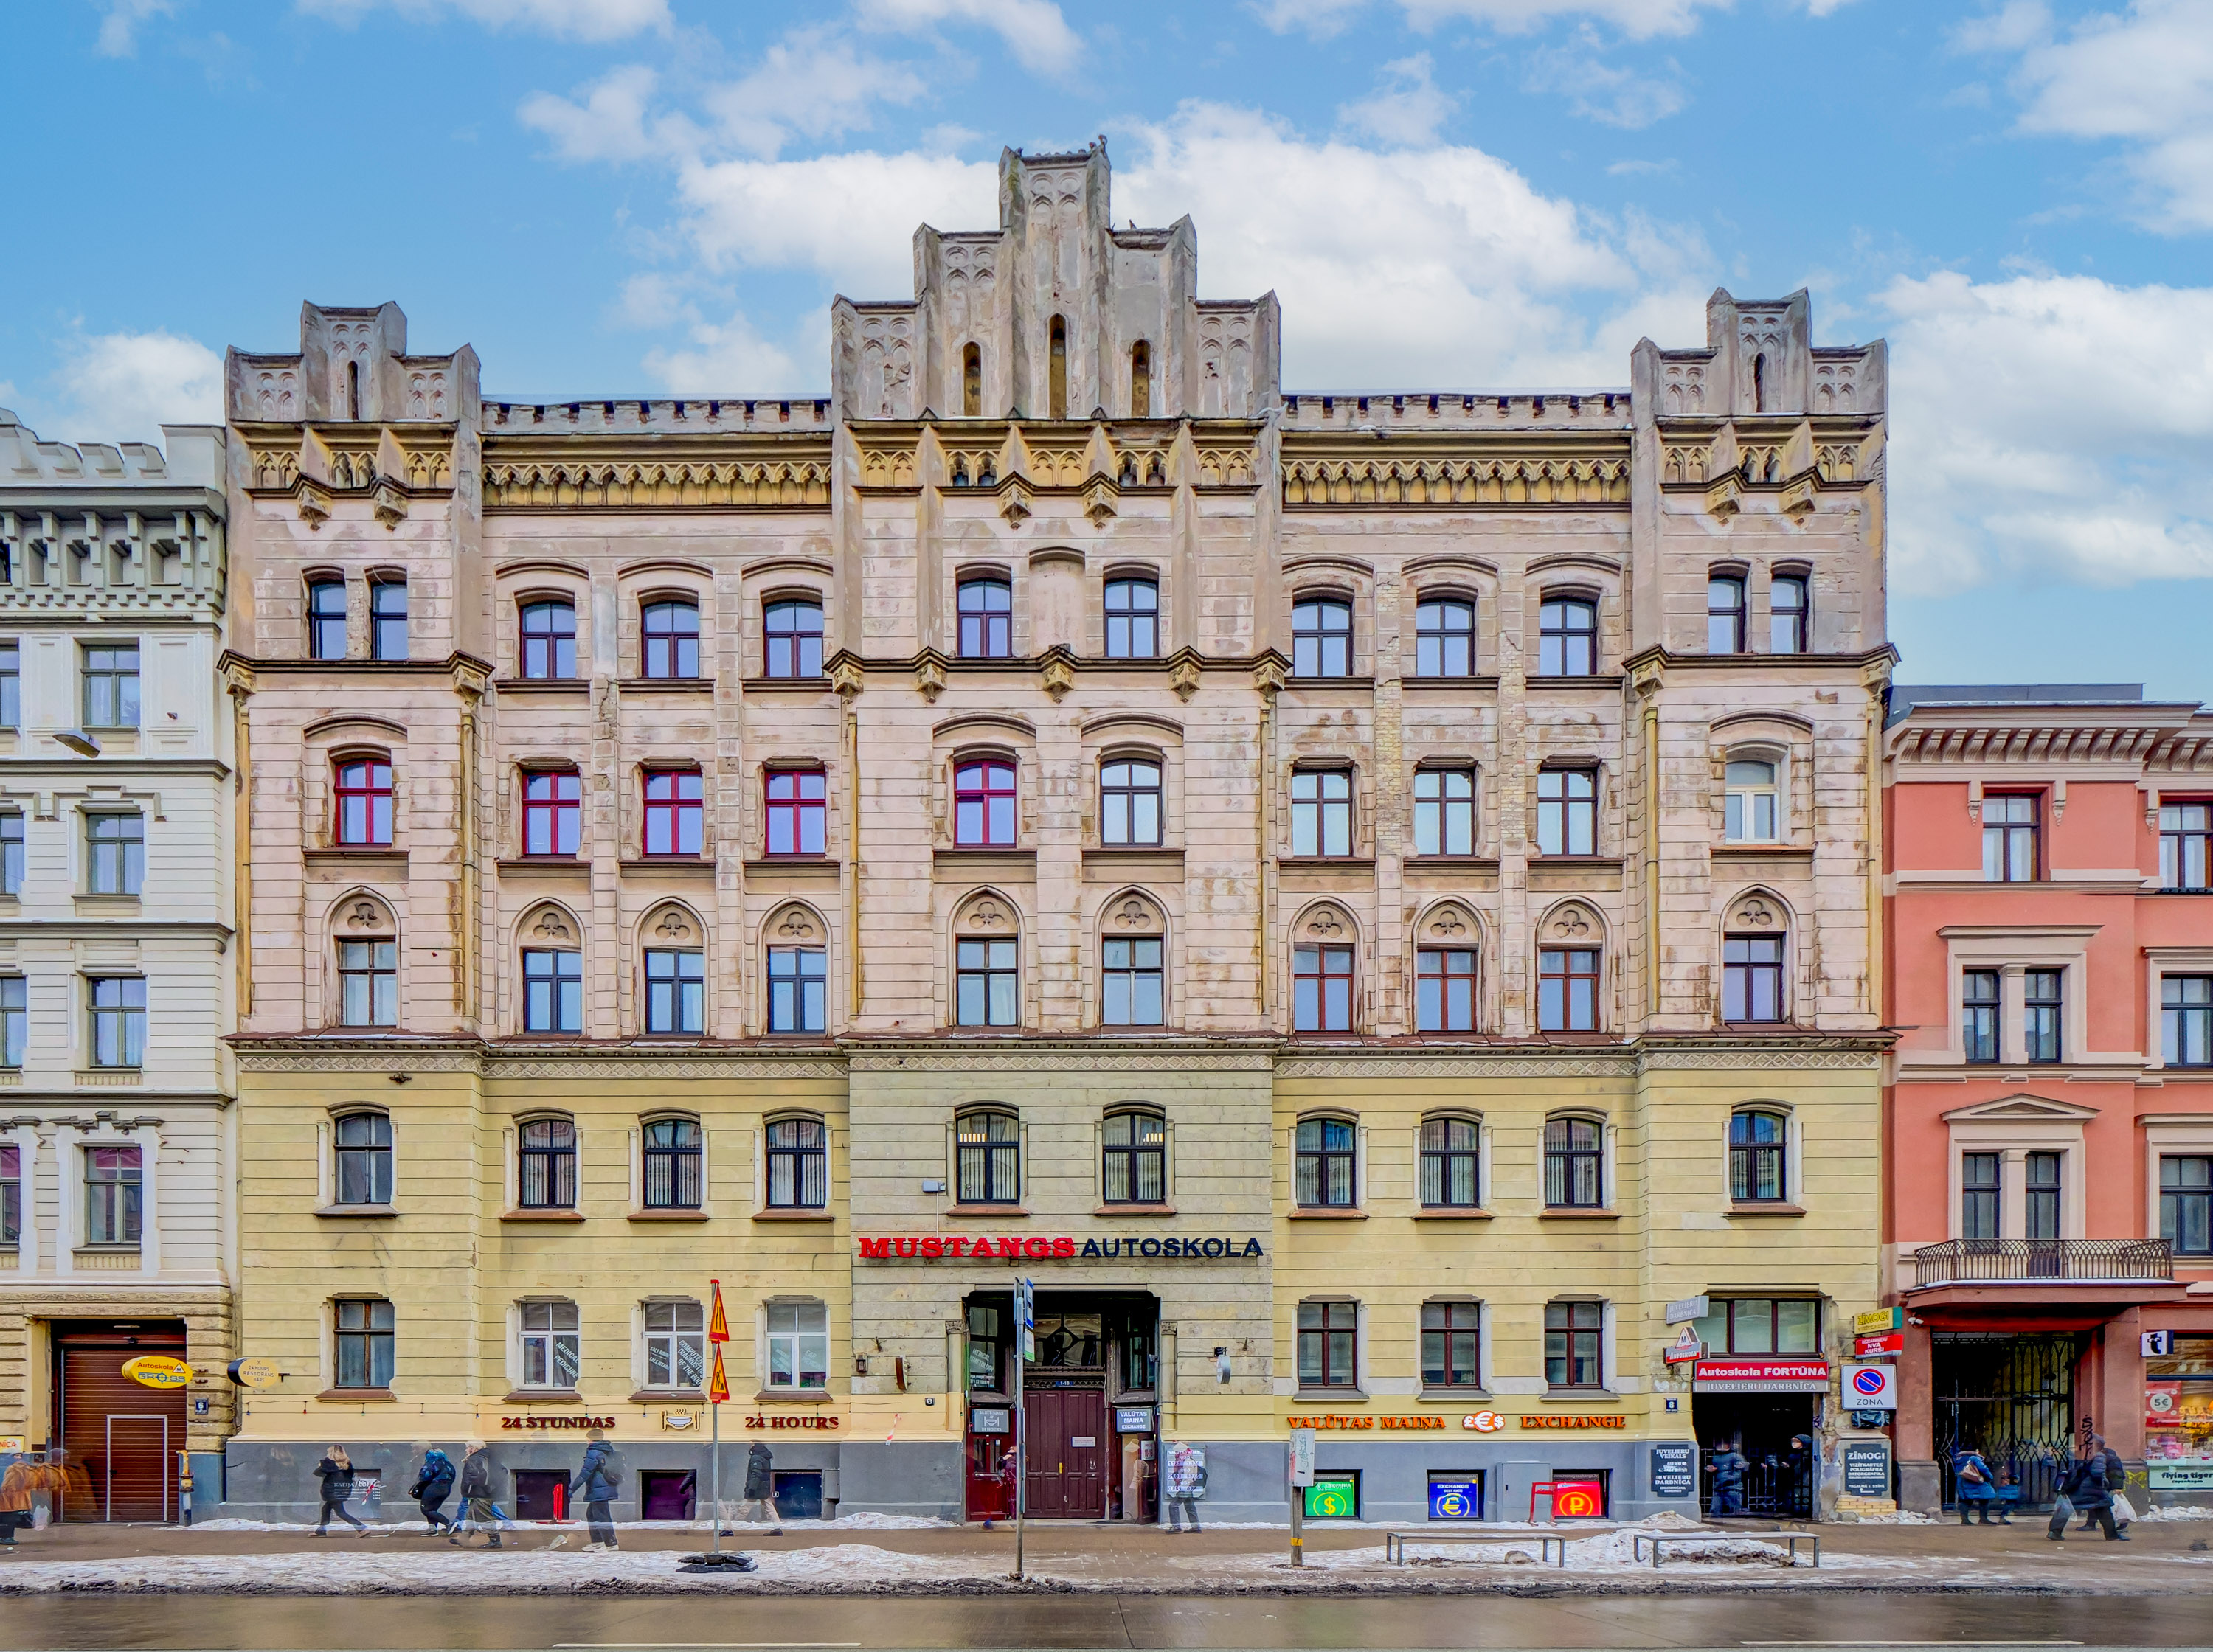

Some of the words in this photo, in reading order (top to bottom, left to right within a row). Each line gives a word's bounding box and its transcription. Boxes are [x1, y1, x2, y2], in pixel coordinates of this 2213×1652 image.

[858, 1237, 1076, 1258] MUSTANGS
[1081, 1237, 1264, 1258] AUTOSKOLA
[555, 1342, 578, 1364] MEDICAL
[679, 1339, 703, 1364] COMPUTER
[1864, 1347, 1885, 1355] KURSI
[137, 1362, 174, 1370] Autoskola
[554, 1355, 578, 1379] PEDICURE
[1698, 1367, 1761, 1376] Autoskola
[1764, 1366, 1826, 1376] FORTŪNA
[138, 1372, 185, 1383] GROSS
[682, 1364, 695, 1376] THE
[690, 1373, 702, 1386] BOD
[1707, 1383, 1761, 1392] JUVELIERU
[1764, 1381, 1817, 1390] DARBNĪCA
[2154, 1398, 2169, 1406] 5€
[501, 1417, 521, 1429] 24
[524, 1416, 616, 1429] STUNDAS
[744, 1416, 765, 1429] 24
[771, 1416, 839, 1429] HOURS
[1286, 1413, 1374, 1429] VALŪTAS
[1380, 1416, 1446, 1430] MAIŅA
[1520, 1415, 1627, 1429] EXCHANGE
[1847, 1451, 1885, 1460] ZĪMOGI
